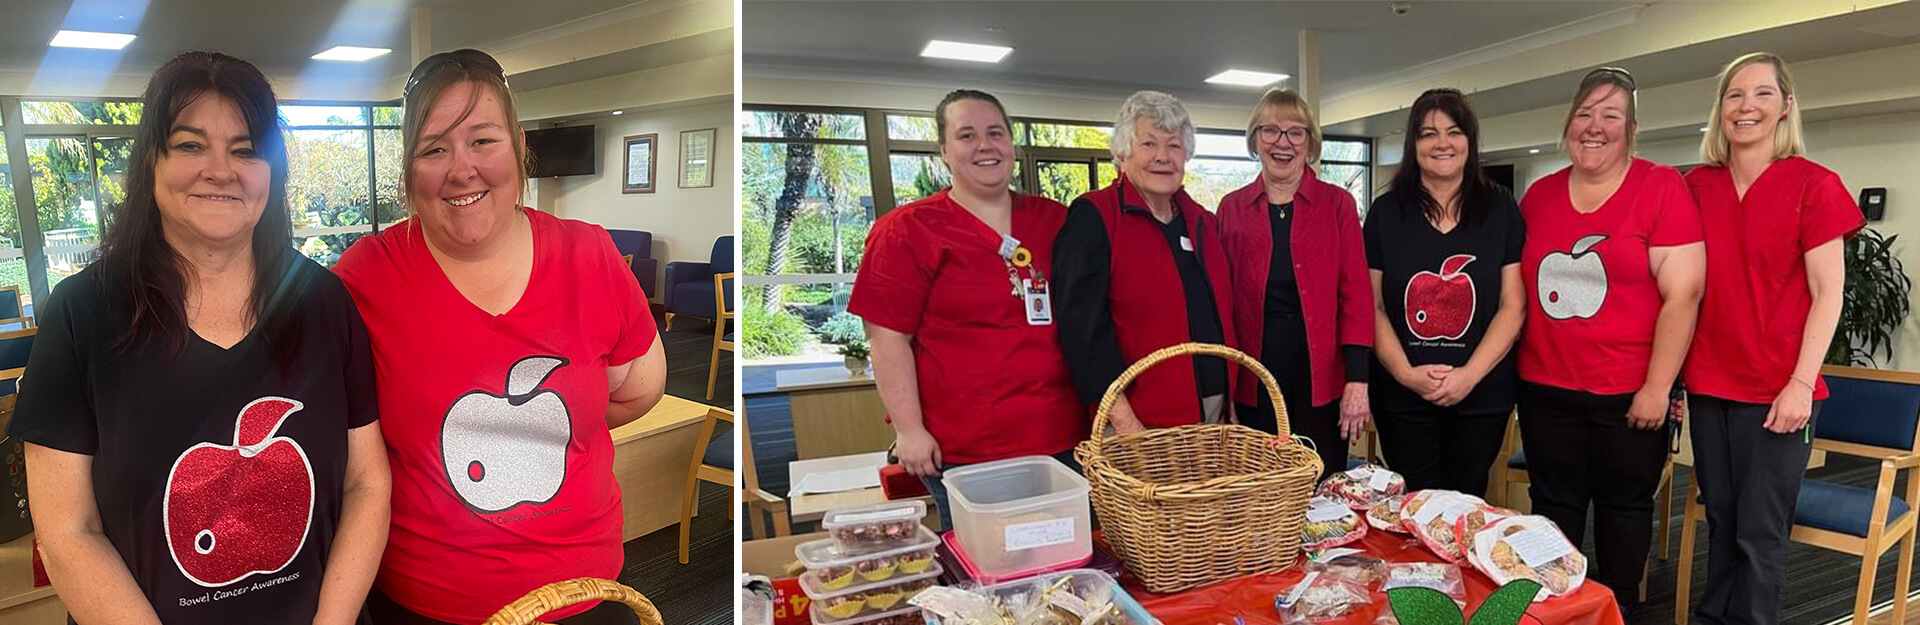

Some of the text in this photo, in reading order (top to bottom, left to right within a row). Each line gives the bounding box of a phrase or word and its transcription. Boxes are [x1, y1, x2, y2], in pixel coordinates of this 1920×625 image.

[496, 513, 527, 525] Cancer
[530, 503, 574, 520] Awareness
[179, 571, 300, 607] Bowel Cancer Awareness
